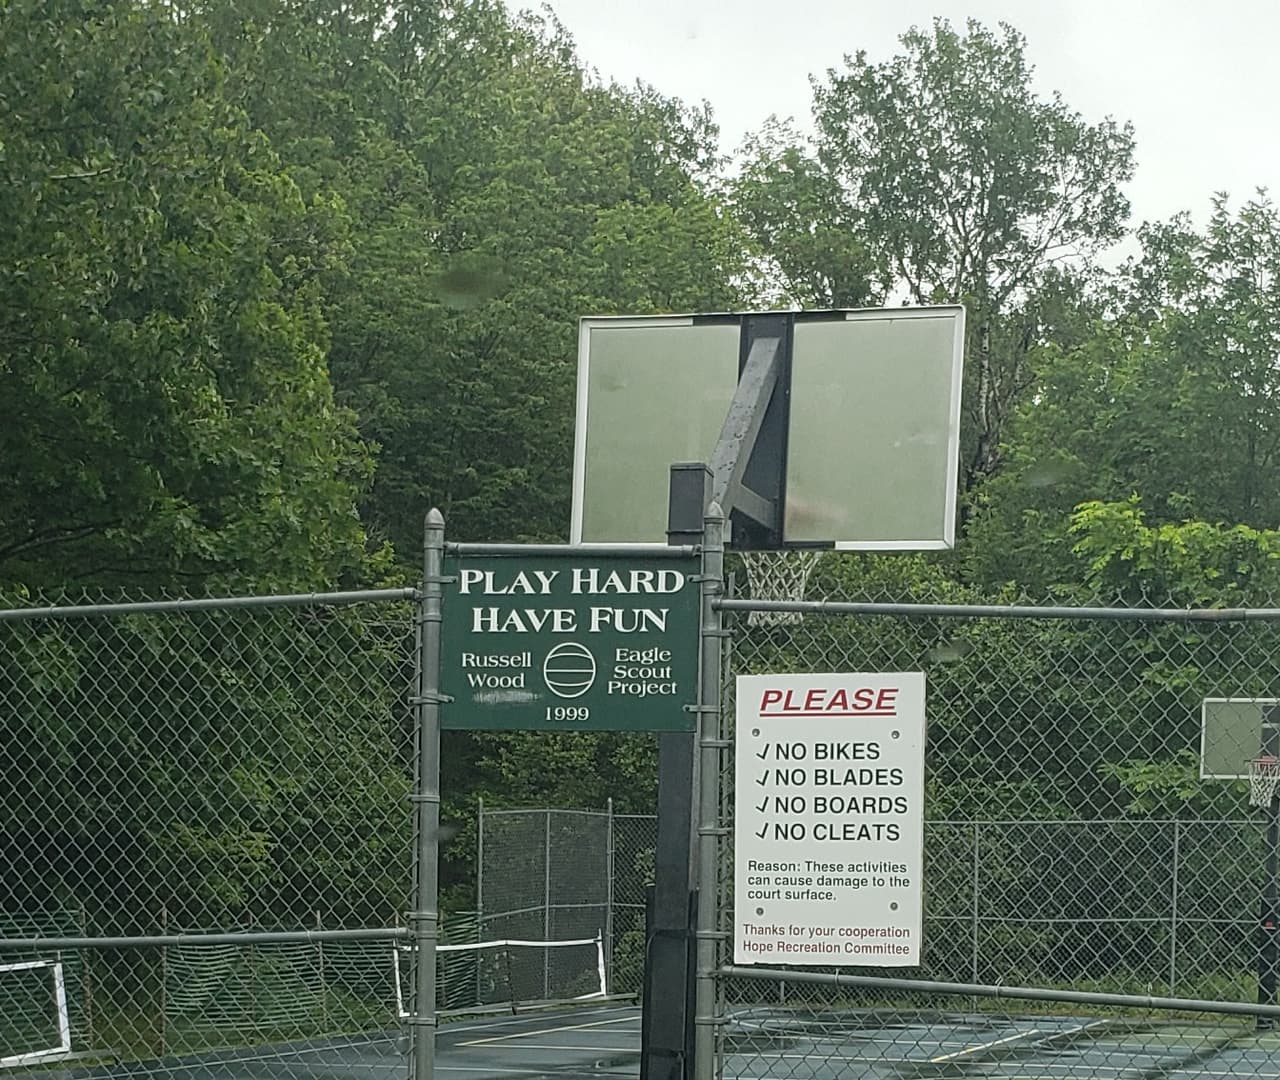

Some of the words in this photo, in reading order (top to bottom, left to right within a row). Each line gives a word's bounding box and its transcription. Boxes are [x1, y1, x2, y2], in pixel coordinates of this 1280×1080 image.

[459, 568, 560, 595] PLAY
[571, 568, 685, 595] HARD
[471, 606, 577, 632] HAVE
[589, 606, 669, 632] FUN
[461, 651, 532, 668] Russell
[615, 647, 672, 665] Eagle
[467, 672, 525, 688] Wood
[614, 664, 672, 679] Scout
[608, 680, 678, 698] Project
[760, 688, 899, 712] PLEASE
[545, 706, 590, 721] 1999
[775, 743, 807, 760] NO
[814, 742, 880, 760] BIKES
[775, 769, 806, 786] NO
[814, 768, 903, 786] BLADES
[774, 797, 806, 814] NO
[813, 796, 908, 814] BOARDS
[774, 823, 806, 841] NO
[813, 823, 900, 841] CLEATS
[748, 860, 801, 872] Reason:
[805, 861, 844, 873] These
[847, 861, 907, 873] activities
[748, 877, 770, 886] can
[774, 877, 813, 886] cause
[816, 876, 868, 889] damage
[872, 877, 885, 887] to
[889, 876, 910, 887] the
[748, 888, 781, 900] court
[785, 888, 837, 901] surface.
[743, 924, 785, 936] Thanks
[788, 924, 805, 936] for
[808, 926, 835, 939] your
[838, 926, 910, 940] cooperation
[743, 941, 773, 954] Hope
[777, 941, 841, 954] Recreation
[844, 942, 910, 955] Committee
